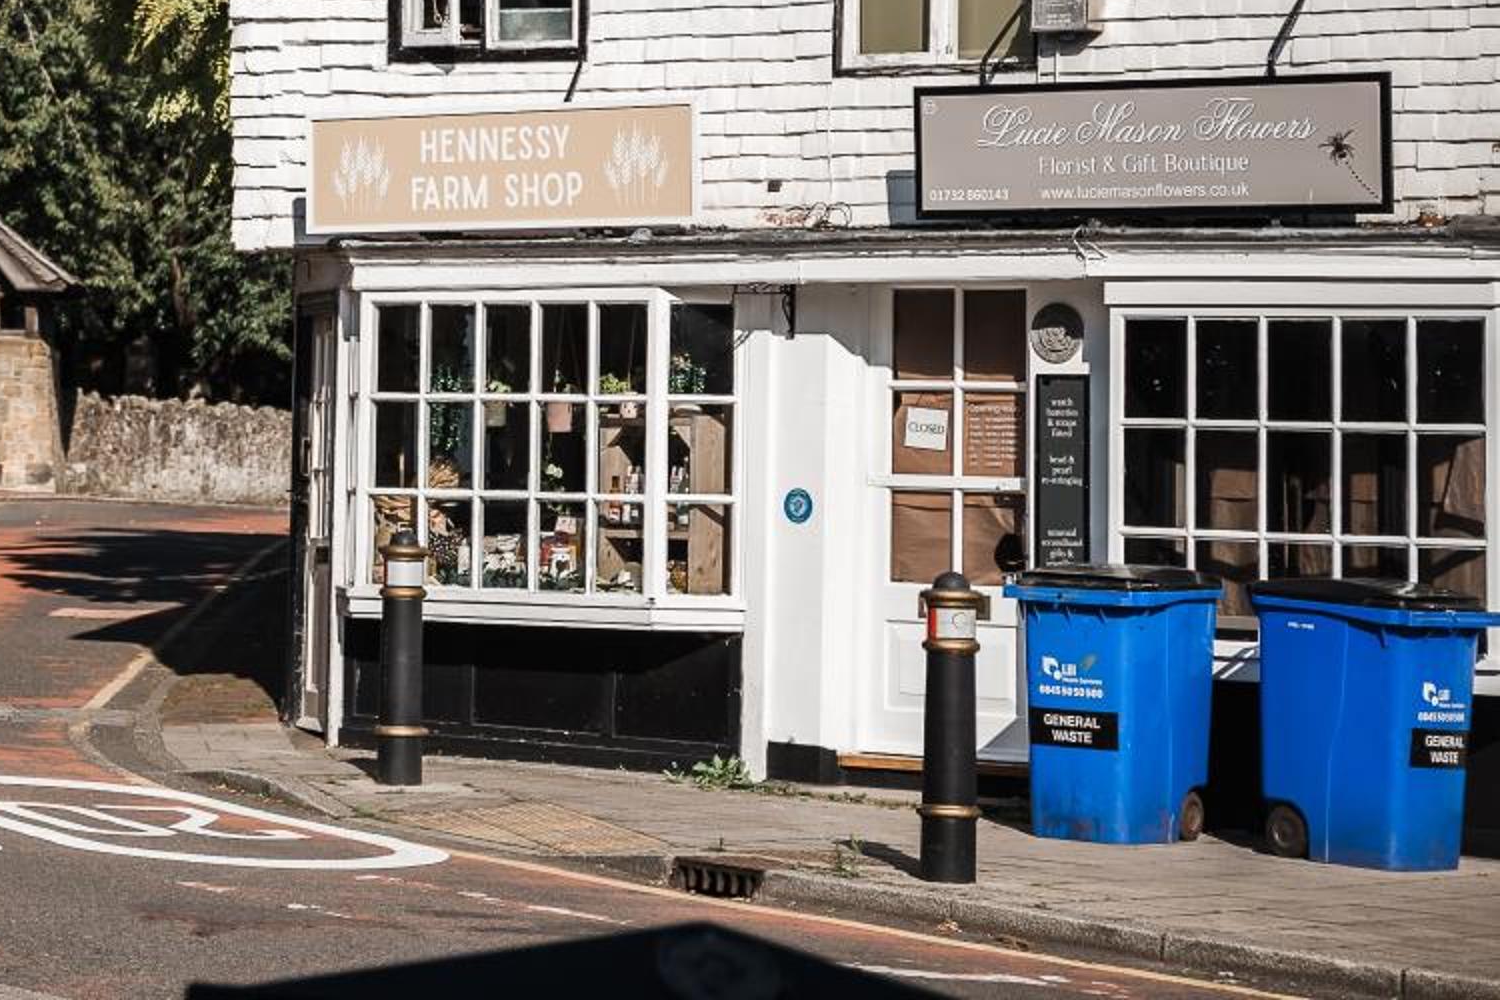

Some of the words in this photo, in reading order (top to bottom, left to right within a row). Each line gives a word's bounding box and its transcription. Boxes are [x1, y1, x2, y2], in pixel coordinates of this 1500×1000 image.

[977, 103, 1071, 149] Lucie
[1075, 100, 1188, 144] Mason
[1193, 96, 1318, 142] Flowers
[419, 124, 570, 164] HENNESSY
[1038, 156, 1097, 175] Florist
[1102, 155, 1116, 174] &
[1123, 153, 1158, 174] Gift
[1165, 152, 1250, 177] Boutique
[411, 174, 489, 211] FARM
[504, 170, 584, 208] SHOP
[1040, 182, 1250, 200] www.luciemasonflowers.co.uk
[907, 421, 945, 435] CLOSED
[1043, 713, 1101, 729] GENERAL
[1051, 729, 1093, 744] WASTE
[1425, 735, 1465, 749] GENERAL
[1429, 751, 1460, 765] WASTE
